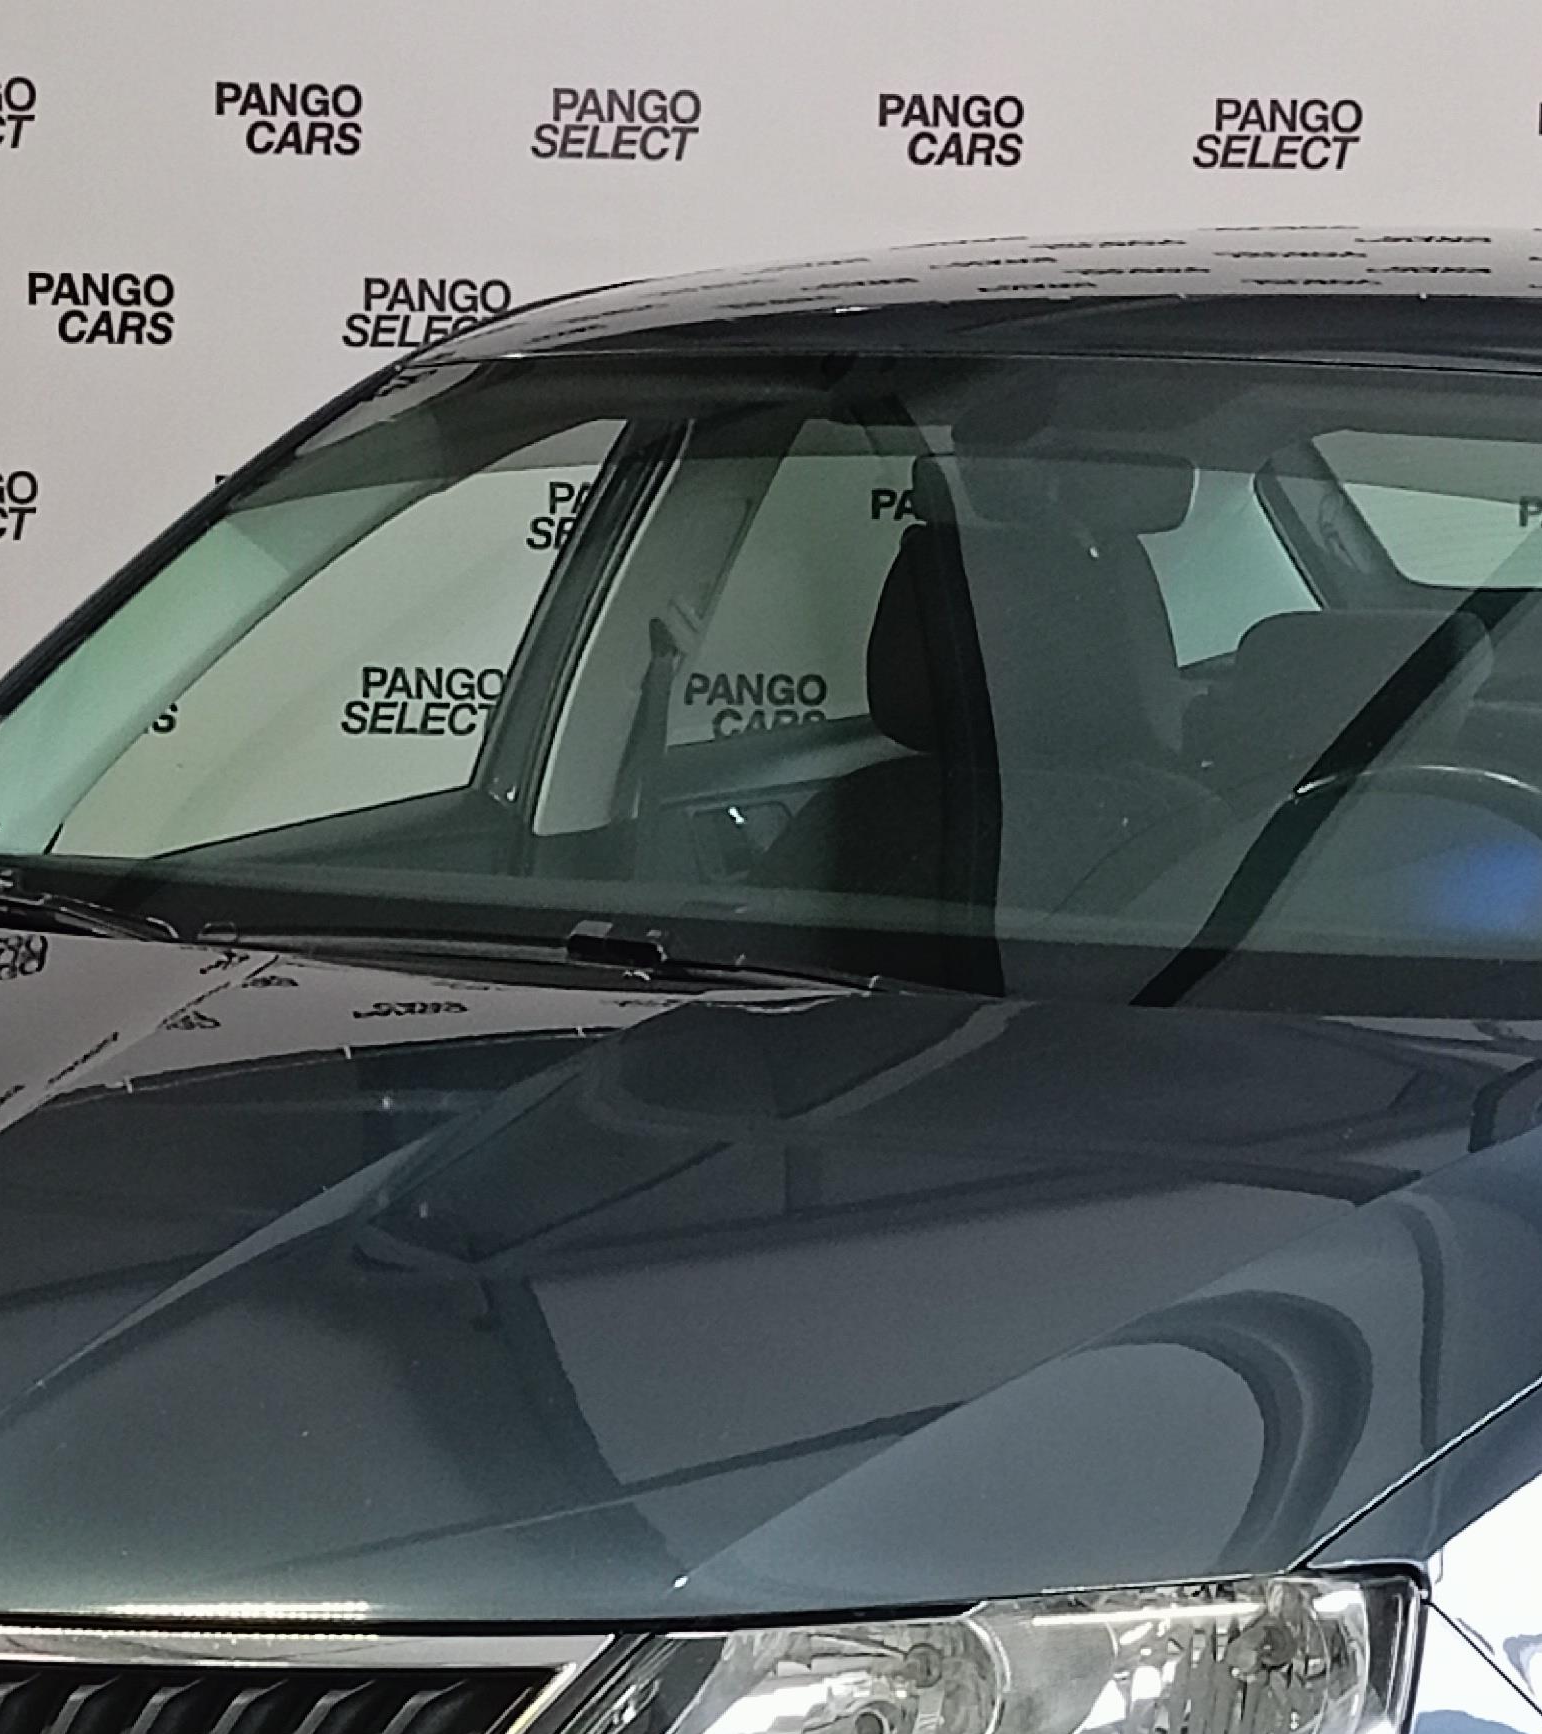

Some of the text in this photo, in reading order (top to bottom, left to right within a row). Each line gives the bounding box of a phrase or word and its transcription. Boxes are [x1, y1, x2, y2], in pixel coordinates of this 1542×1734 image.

[216, 82, 362, 119] PANGO
[553, 88, 701, 124] PANGO
[879, 94, 1024, 128] PANGO
[1216, 98, 1363, 133] PANGO
[246, 121, 362, 155] CARS
[531, 124, 699, 161] SELECT
[907, 132, 1023, 167] CARS
[1193, 134, 1360, 169] SELECT
[28, 272, 174, 307] PANGO
[364, 278, 511, 314] PANGO
[58, 309, 175, 344] CARS
[363, 667, 506, 700] PANGO
[684, 673, 826, 705] PANGO
